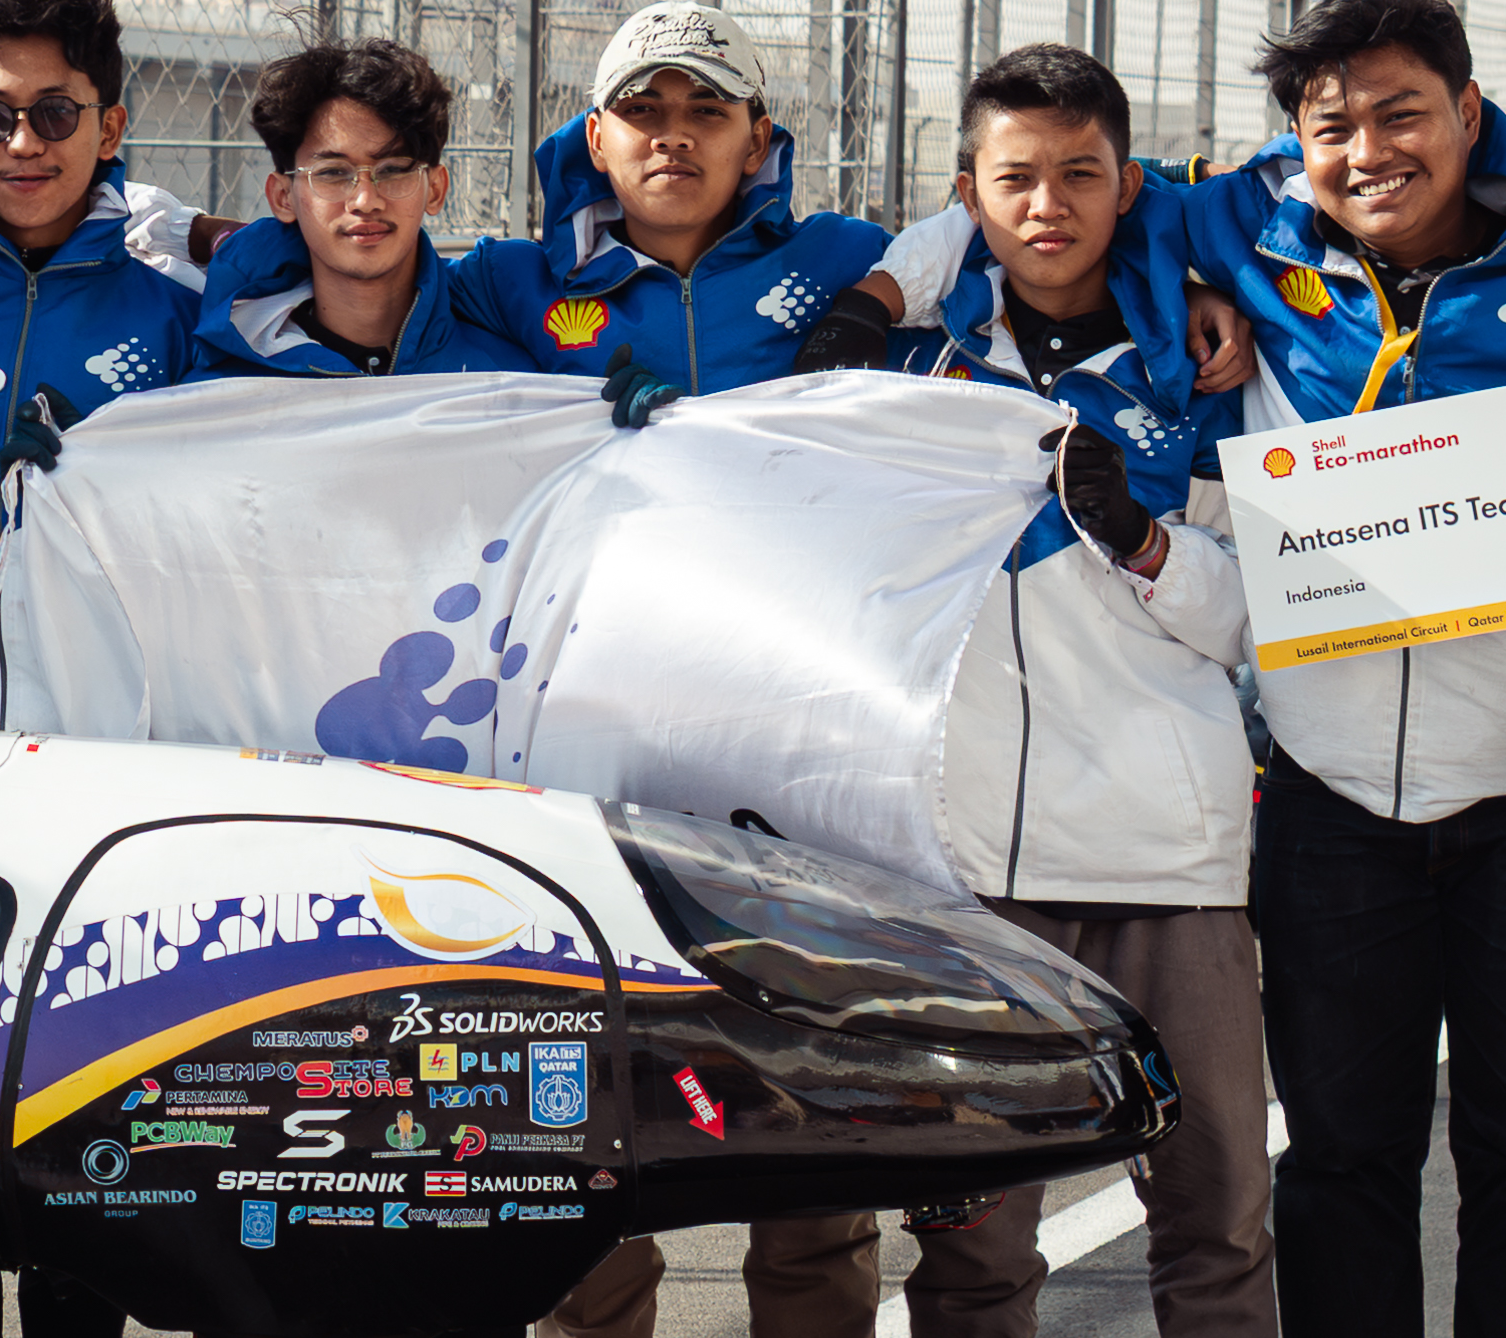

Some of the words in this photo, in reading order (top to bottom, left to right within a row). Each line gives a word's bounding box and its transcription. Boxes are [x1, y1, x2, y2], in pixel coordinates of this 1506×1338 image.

[1311, 435, 1347, 454] Shell
[1313, 430, 1460, 472] Eco-marathon
[1277, 512, 1410, 557] Antasena
[1418, 501, 1460, 533] ITS
[1285, 577, 1367, 605] Indonesia
[1296, 640, 1330, 659] Lusail
[1332, 627, 1408, 653] International
[1410, 620, 1448, 642] Circuit
[1467, 610, 1505, 630] Qatar
[439, 1012, 604, 1034] SOLIDWORKS
[253, 1031, 354, 1048] MERATUS
[461, 1051, 520, 1073] PLN
[534, 1047, 558, 1060] IKA
[538, 1061, 578, 1074] QATAR
[166, 1090, 248, 1104] PERTAMINA
[680, 1075, 702, 1098] LIFT
[692, 1095, 717, 1124] HERE
[131, 1121, 234, 1147] PCBWay
[490, 1133, 519, 1145] PANJI
[522, 1134, 569, 1146] PERKASA
[216, 1170, 408, 1193] SPECTRONIK
[471, 1175, 578, 1192] SAMUDERA
[45, 1191, 98, 1206] ASIAN
[104, 1189, 197, 1205] BEARINDO
[104, 1210, 139, 1218] GROUP
[307, 1205, 375, 1219] PELINDO
[408, 1208, 490, 1221] KRAKATAU
[518, 1205, 585, 1217] PELINDO
